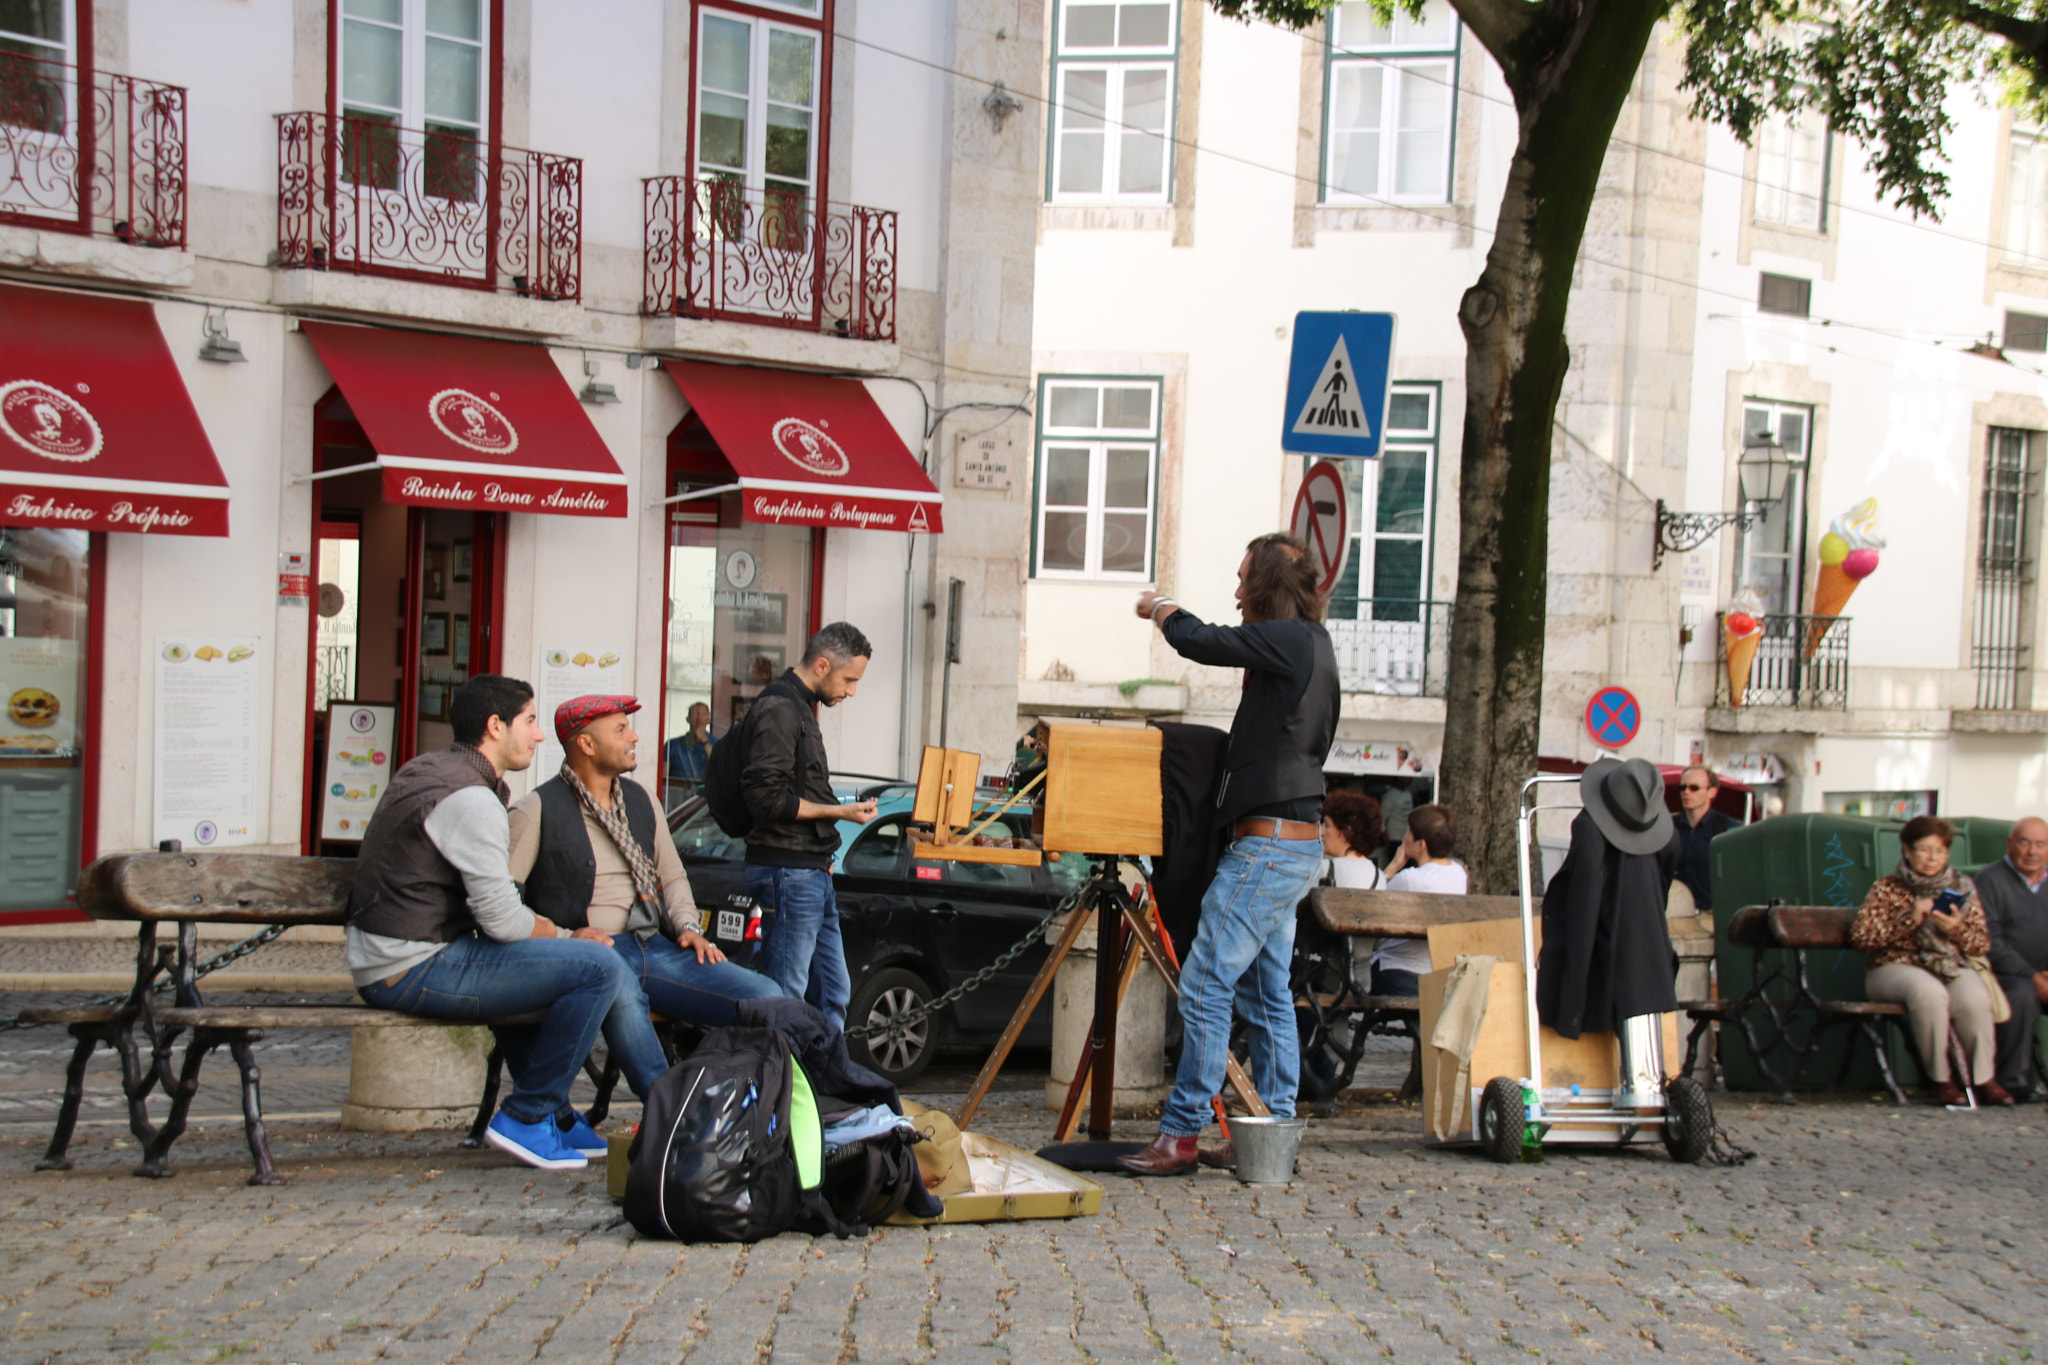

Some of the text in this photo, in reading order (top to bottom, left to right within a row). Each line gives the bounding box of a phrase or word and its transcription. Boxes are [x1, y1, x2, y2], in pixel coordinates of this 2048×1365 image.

[402, 476, 609, 510] Rainha Dona Amélia
[7, 493, 193, 533] Fabrico Próprio
[753, 496, 896, 529] Confeitaria Portuguesa
[721, 913, 741, 927] 599
